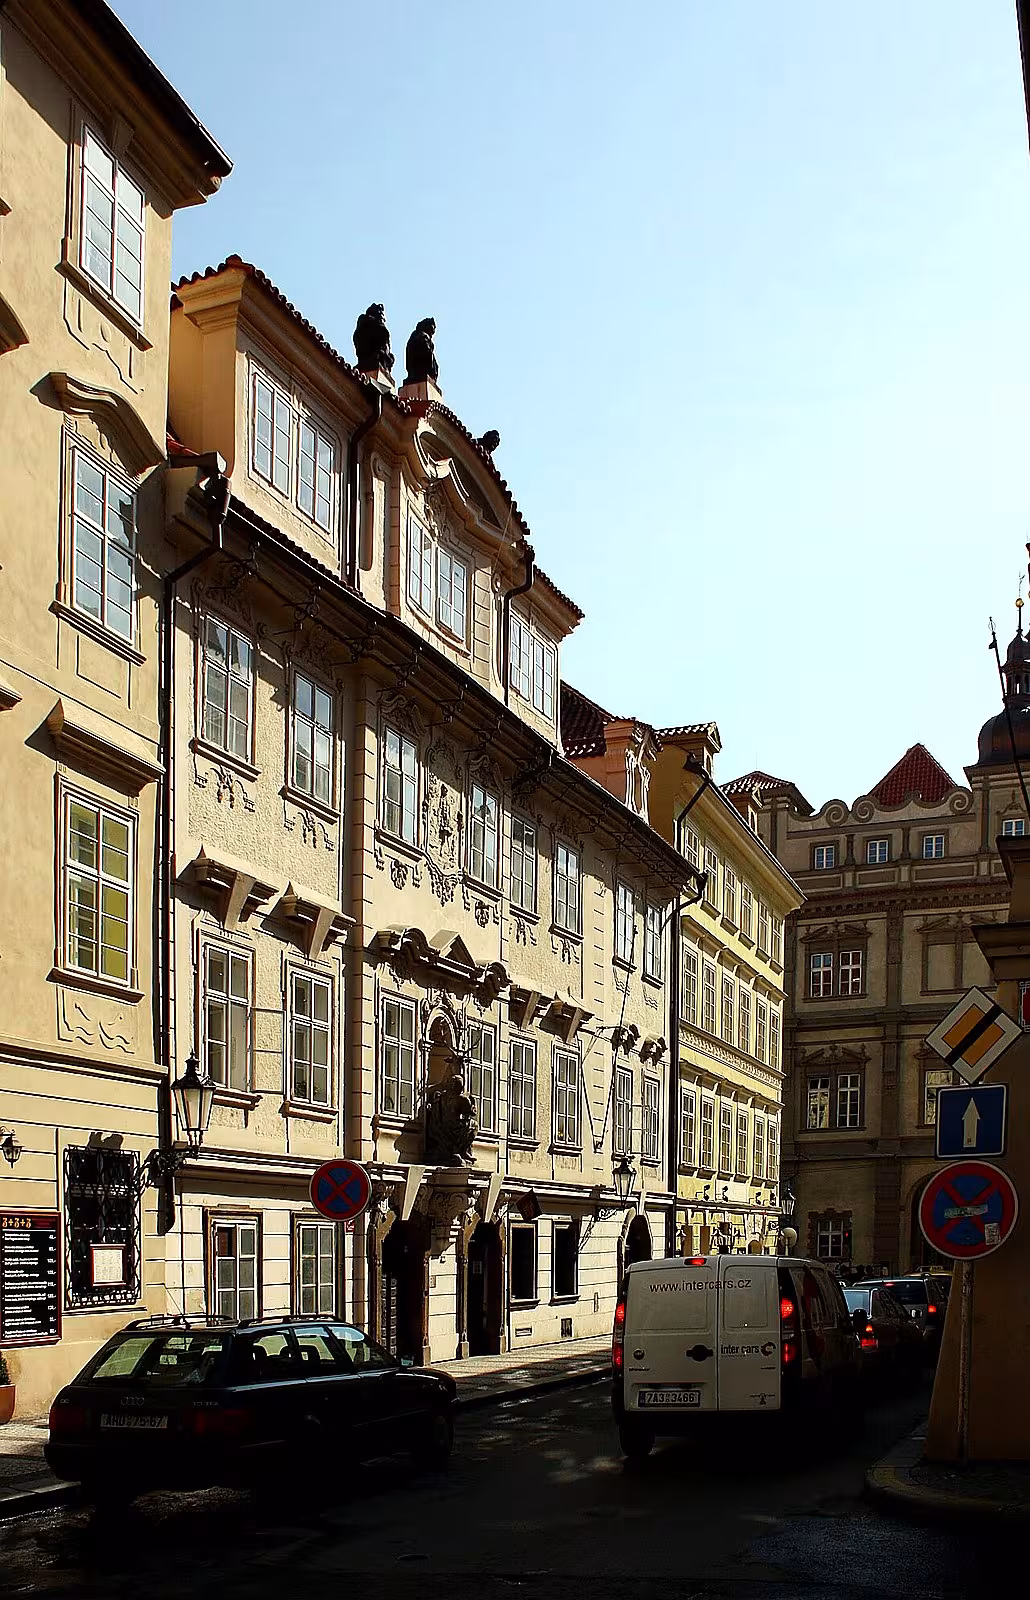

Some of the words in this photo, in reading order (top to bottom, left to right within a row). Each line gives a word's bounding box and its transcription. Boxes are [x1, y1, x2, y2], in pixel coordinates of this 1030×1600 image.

[649, 1278, 752, 1292] www.intercars.cz
[721, 1344, 739, 1354] inter
[741, 1345, 760, 1354] cars
